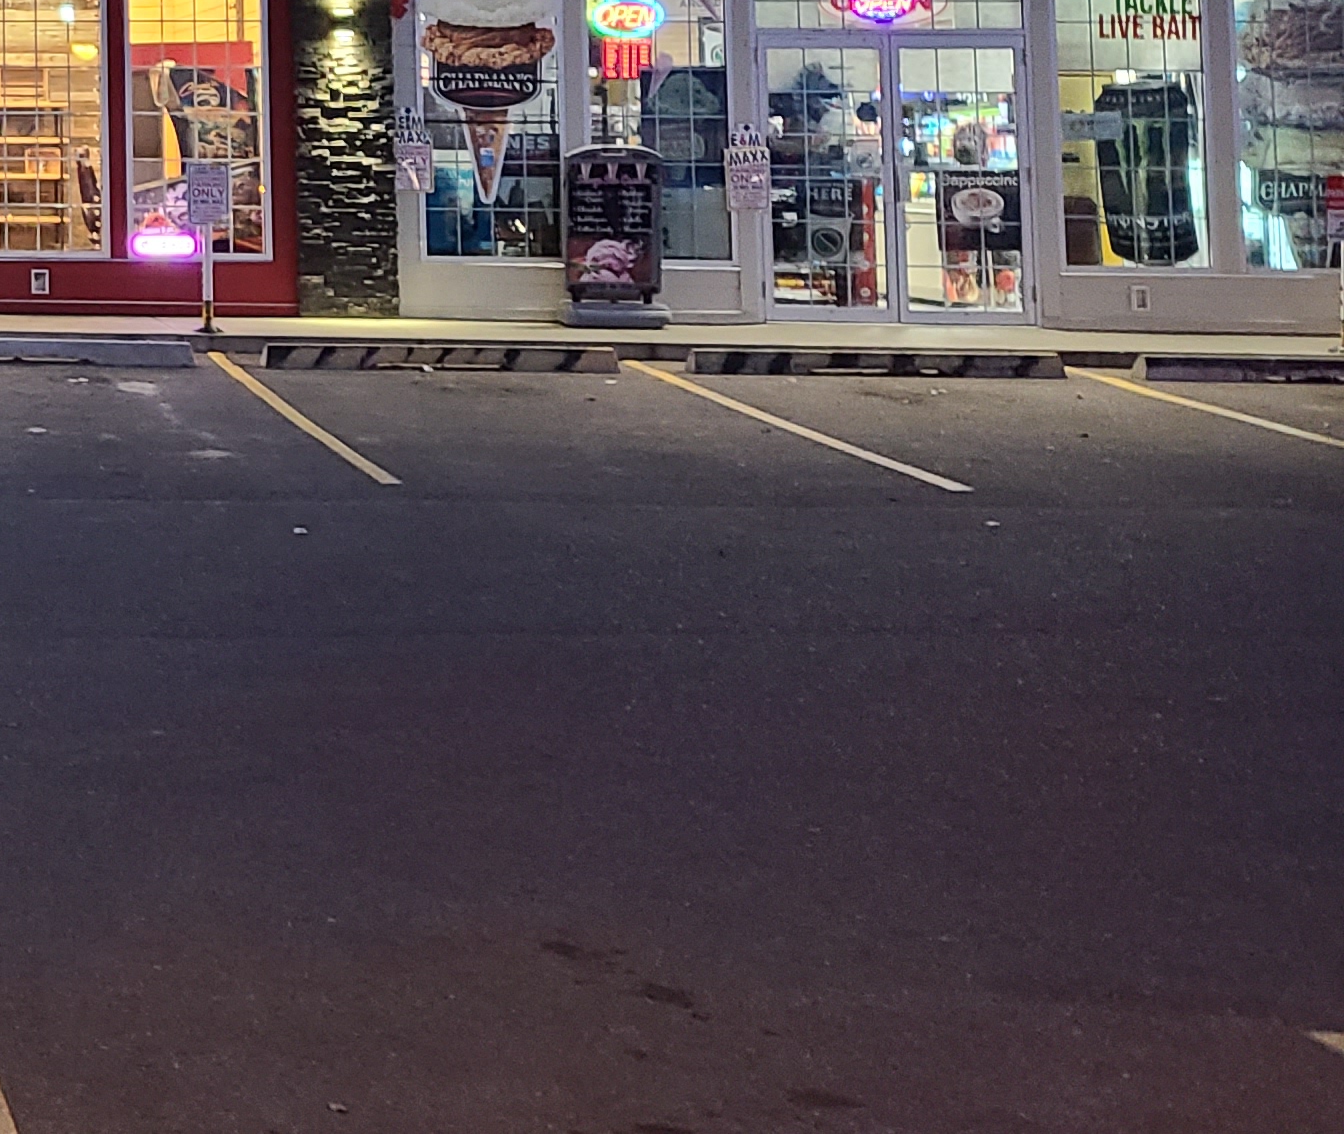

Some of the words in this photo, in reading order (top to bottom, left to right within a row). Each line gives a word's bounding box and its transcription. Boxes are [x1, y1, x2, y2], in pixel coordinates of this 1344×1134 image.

[597, 4, 657, 29] OPEN
[1099, 13, 1144, 40] LIVE
[1152, 13, 1202, 41] BAIT
[438, 72, 534, 93] CHAPMAN'S
[729, 149, 768, 166] MAXX
[192, 188, 224, 198] ONLY
